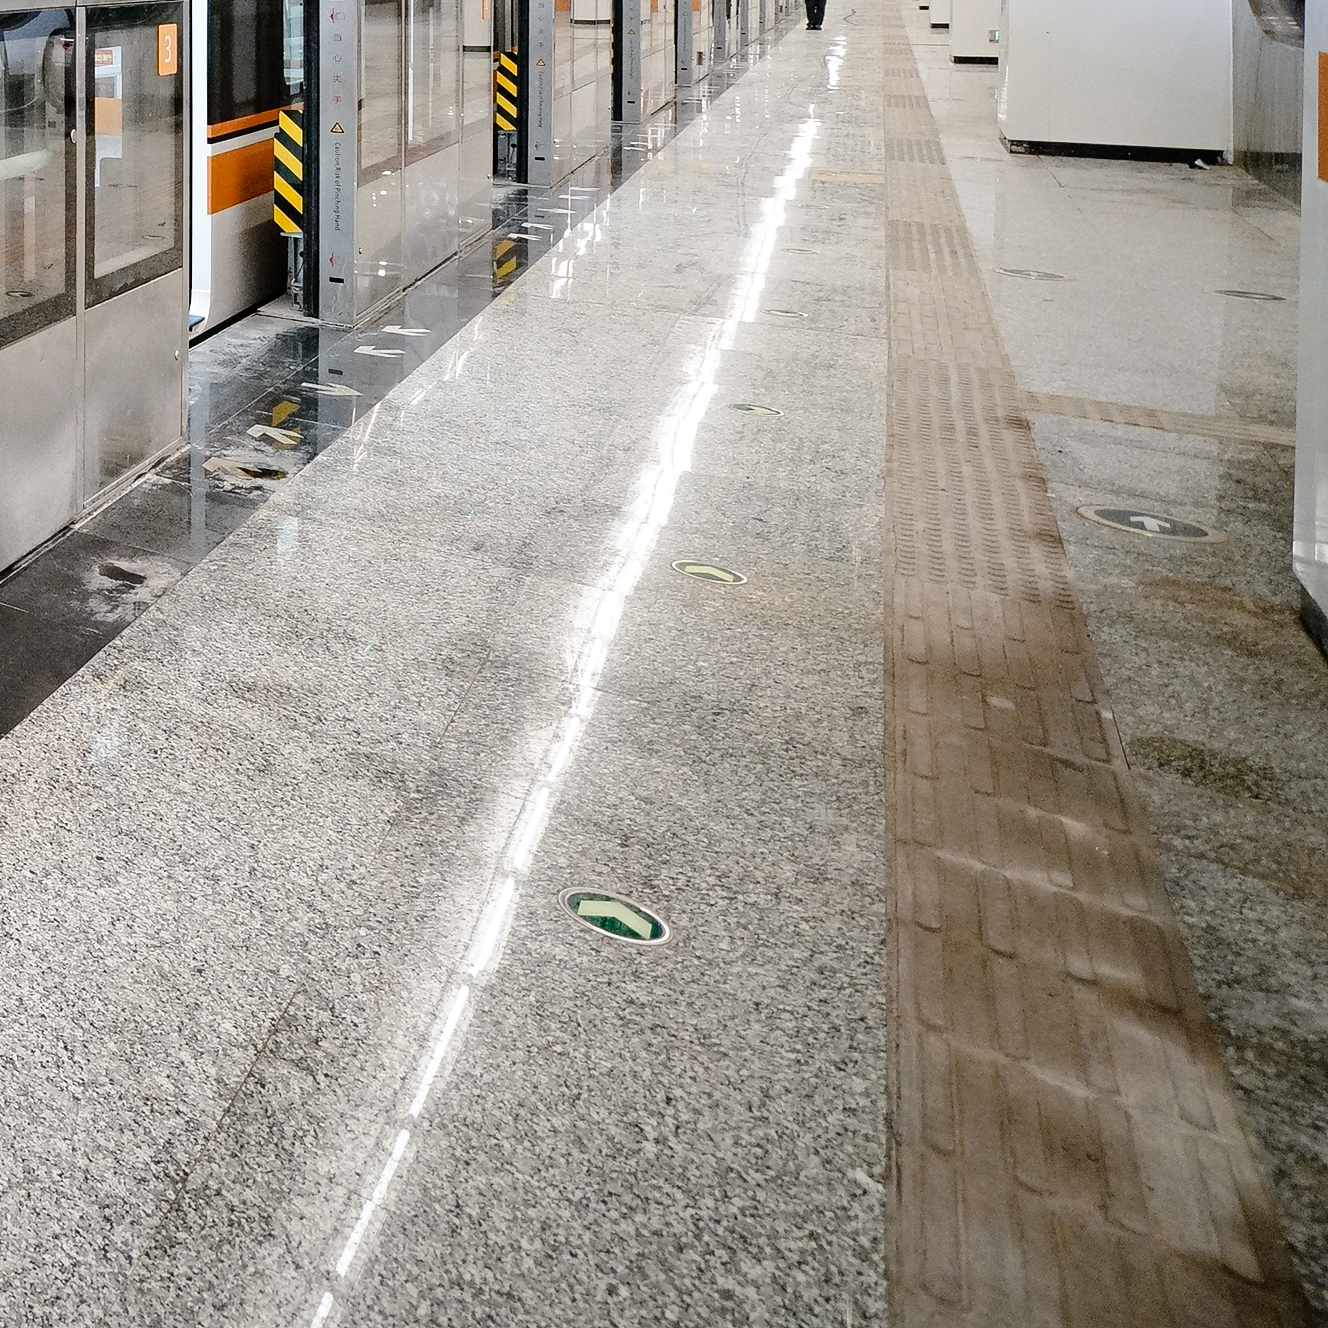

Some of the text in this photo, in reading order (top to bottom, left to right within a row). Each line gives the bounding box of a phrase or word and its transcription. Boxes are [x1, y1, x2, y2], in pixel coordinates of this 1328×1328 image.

[164, 35, 172, 63] 3
[332, 33, 343, 104] 当心夹手
